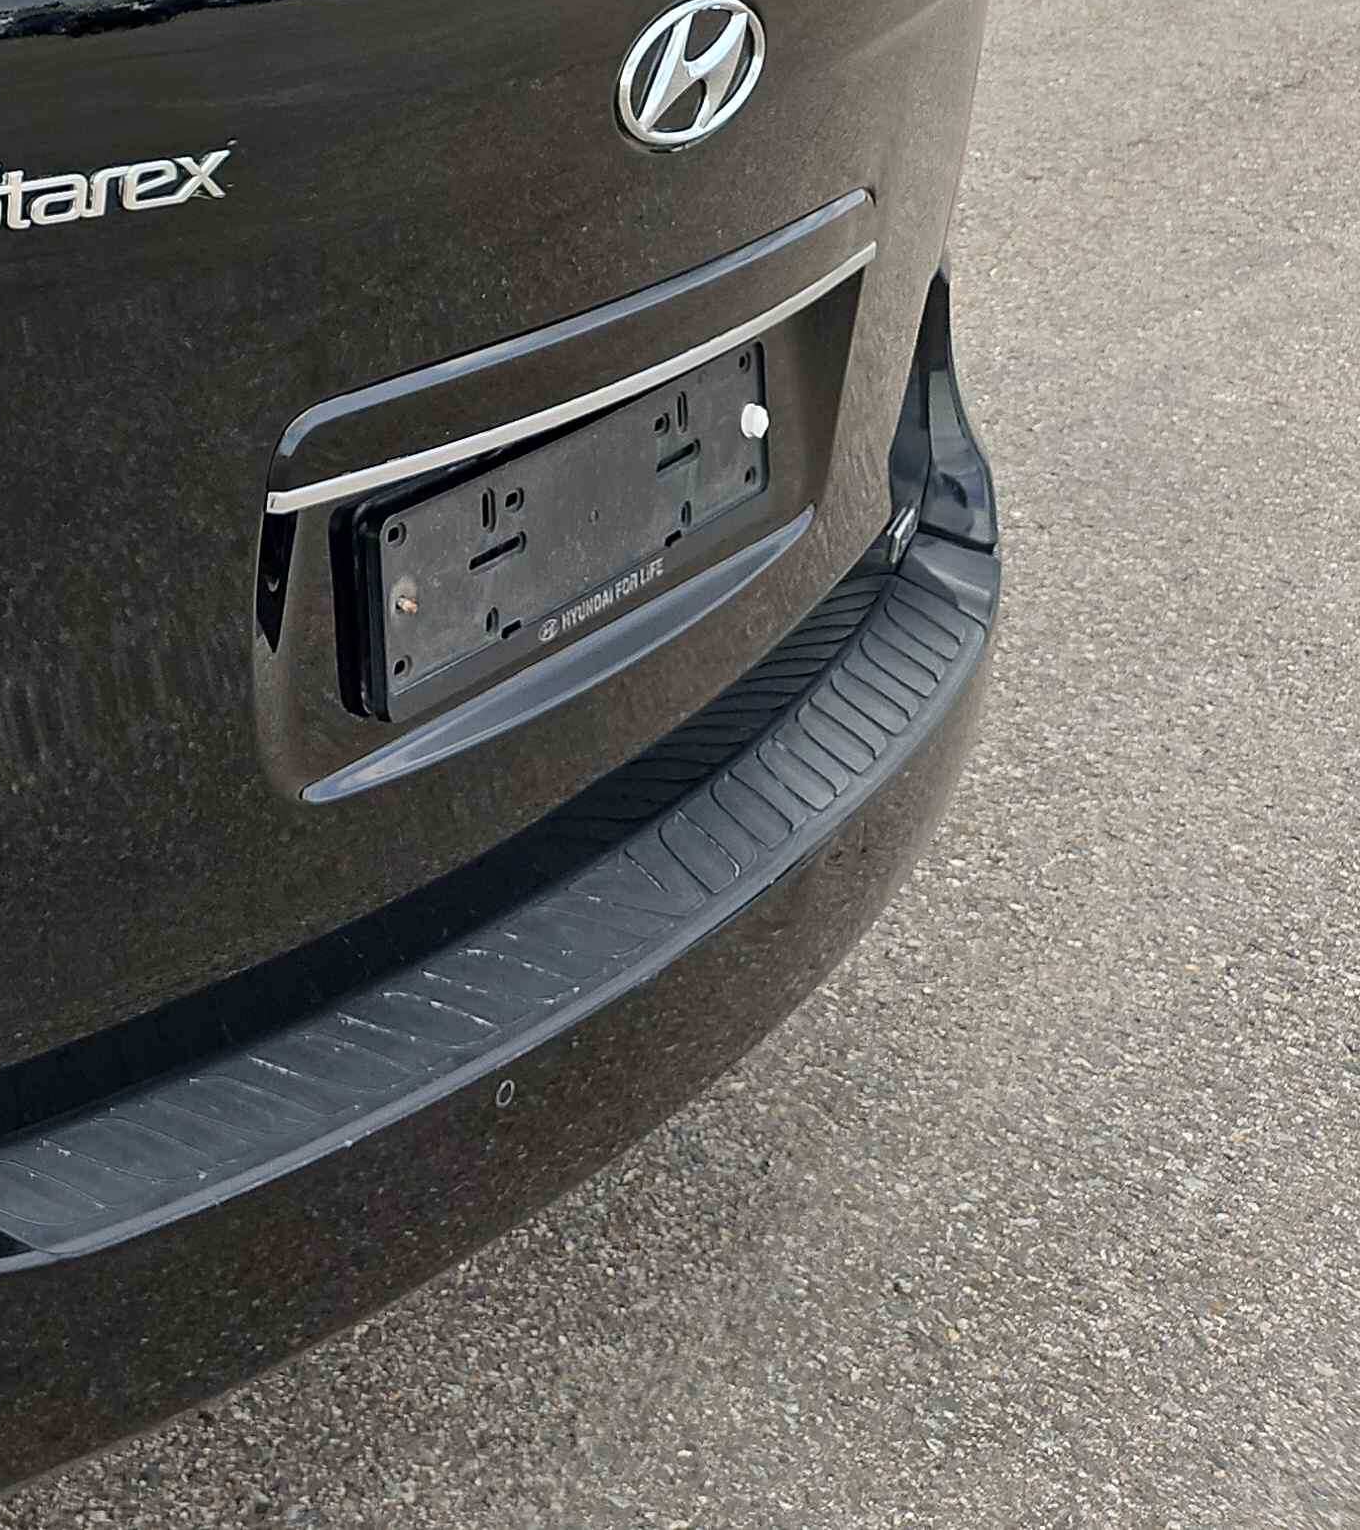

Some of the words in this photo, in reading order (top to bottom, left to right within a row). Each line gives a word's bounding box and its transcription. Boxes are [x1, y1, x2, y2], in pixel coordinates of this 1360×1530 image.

[561, 587, 614, 630] HYUNDAI
[615, 573, 638, 599] FOR
[640, 557, 665, 584] LIFE
